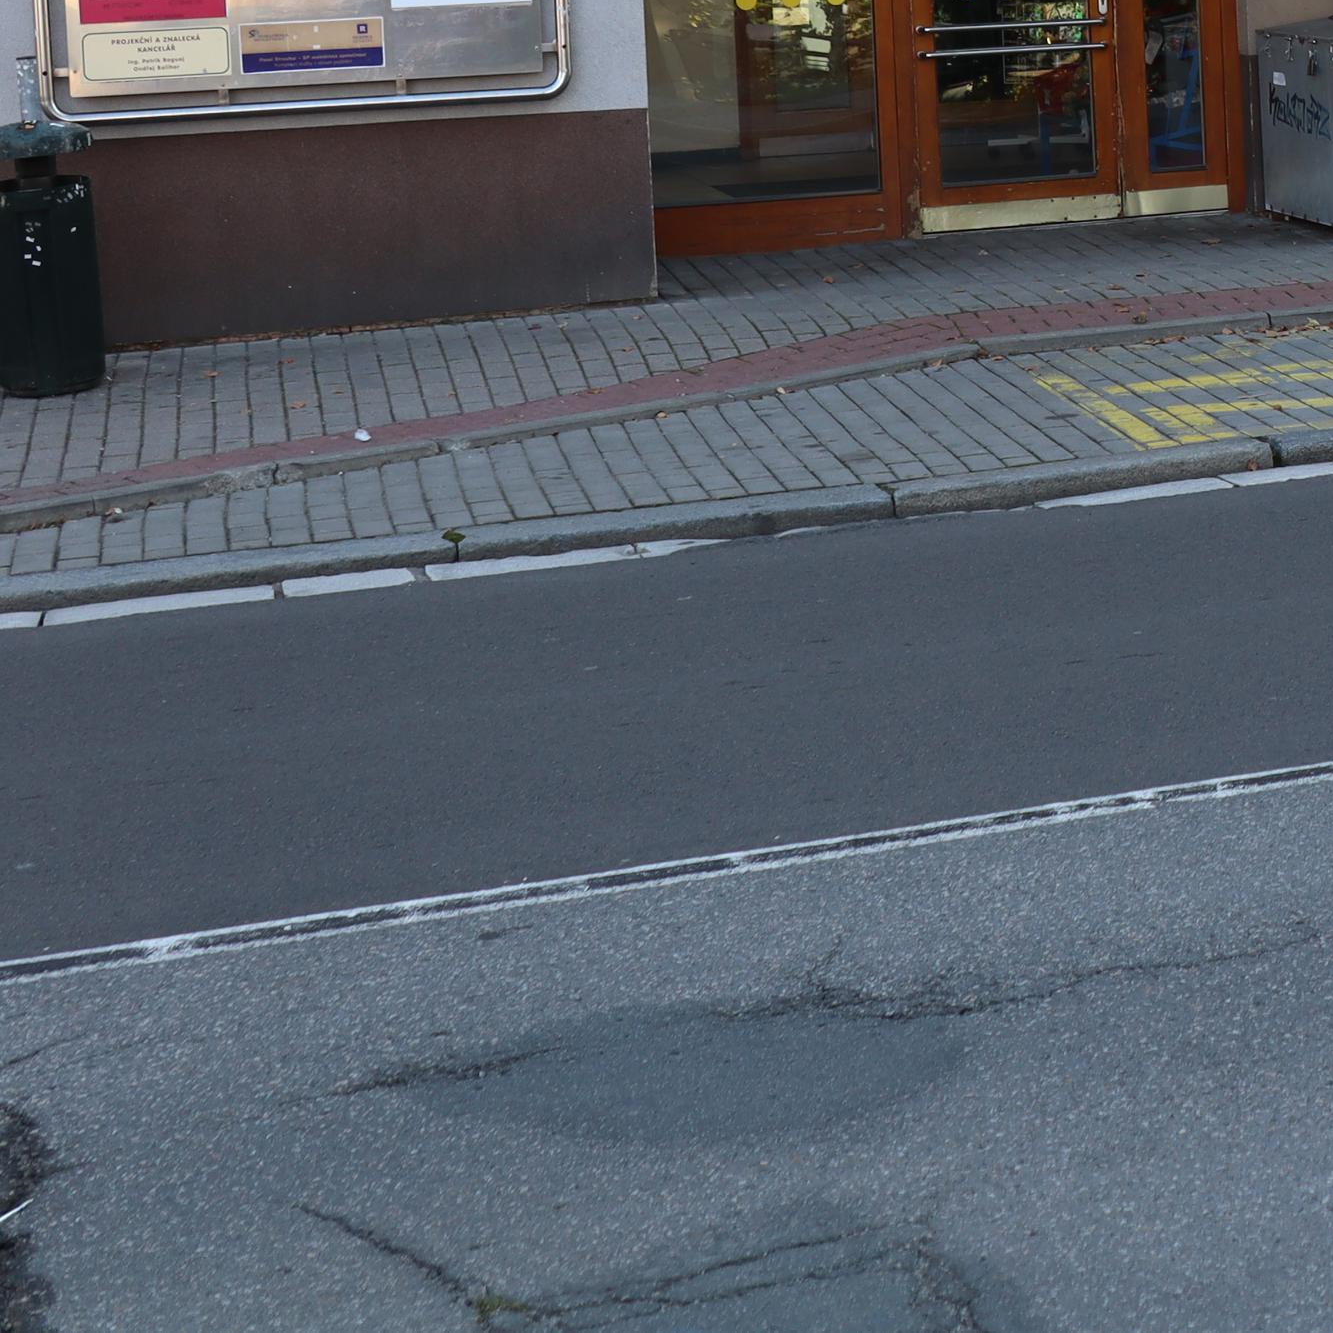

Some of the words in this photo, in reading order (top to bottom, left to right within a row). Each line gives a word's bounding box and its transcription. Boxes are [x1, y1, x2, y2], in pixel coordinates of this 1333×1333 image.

[111, 36, 153, 45] PROJEKČNÍ
[163, 34, 200, 43] ZNALECKÁ
[137, 44, 176, 53] KANCELÁŘ
